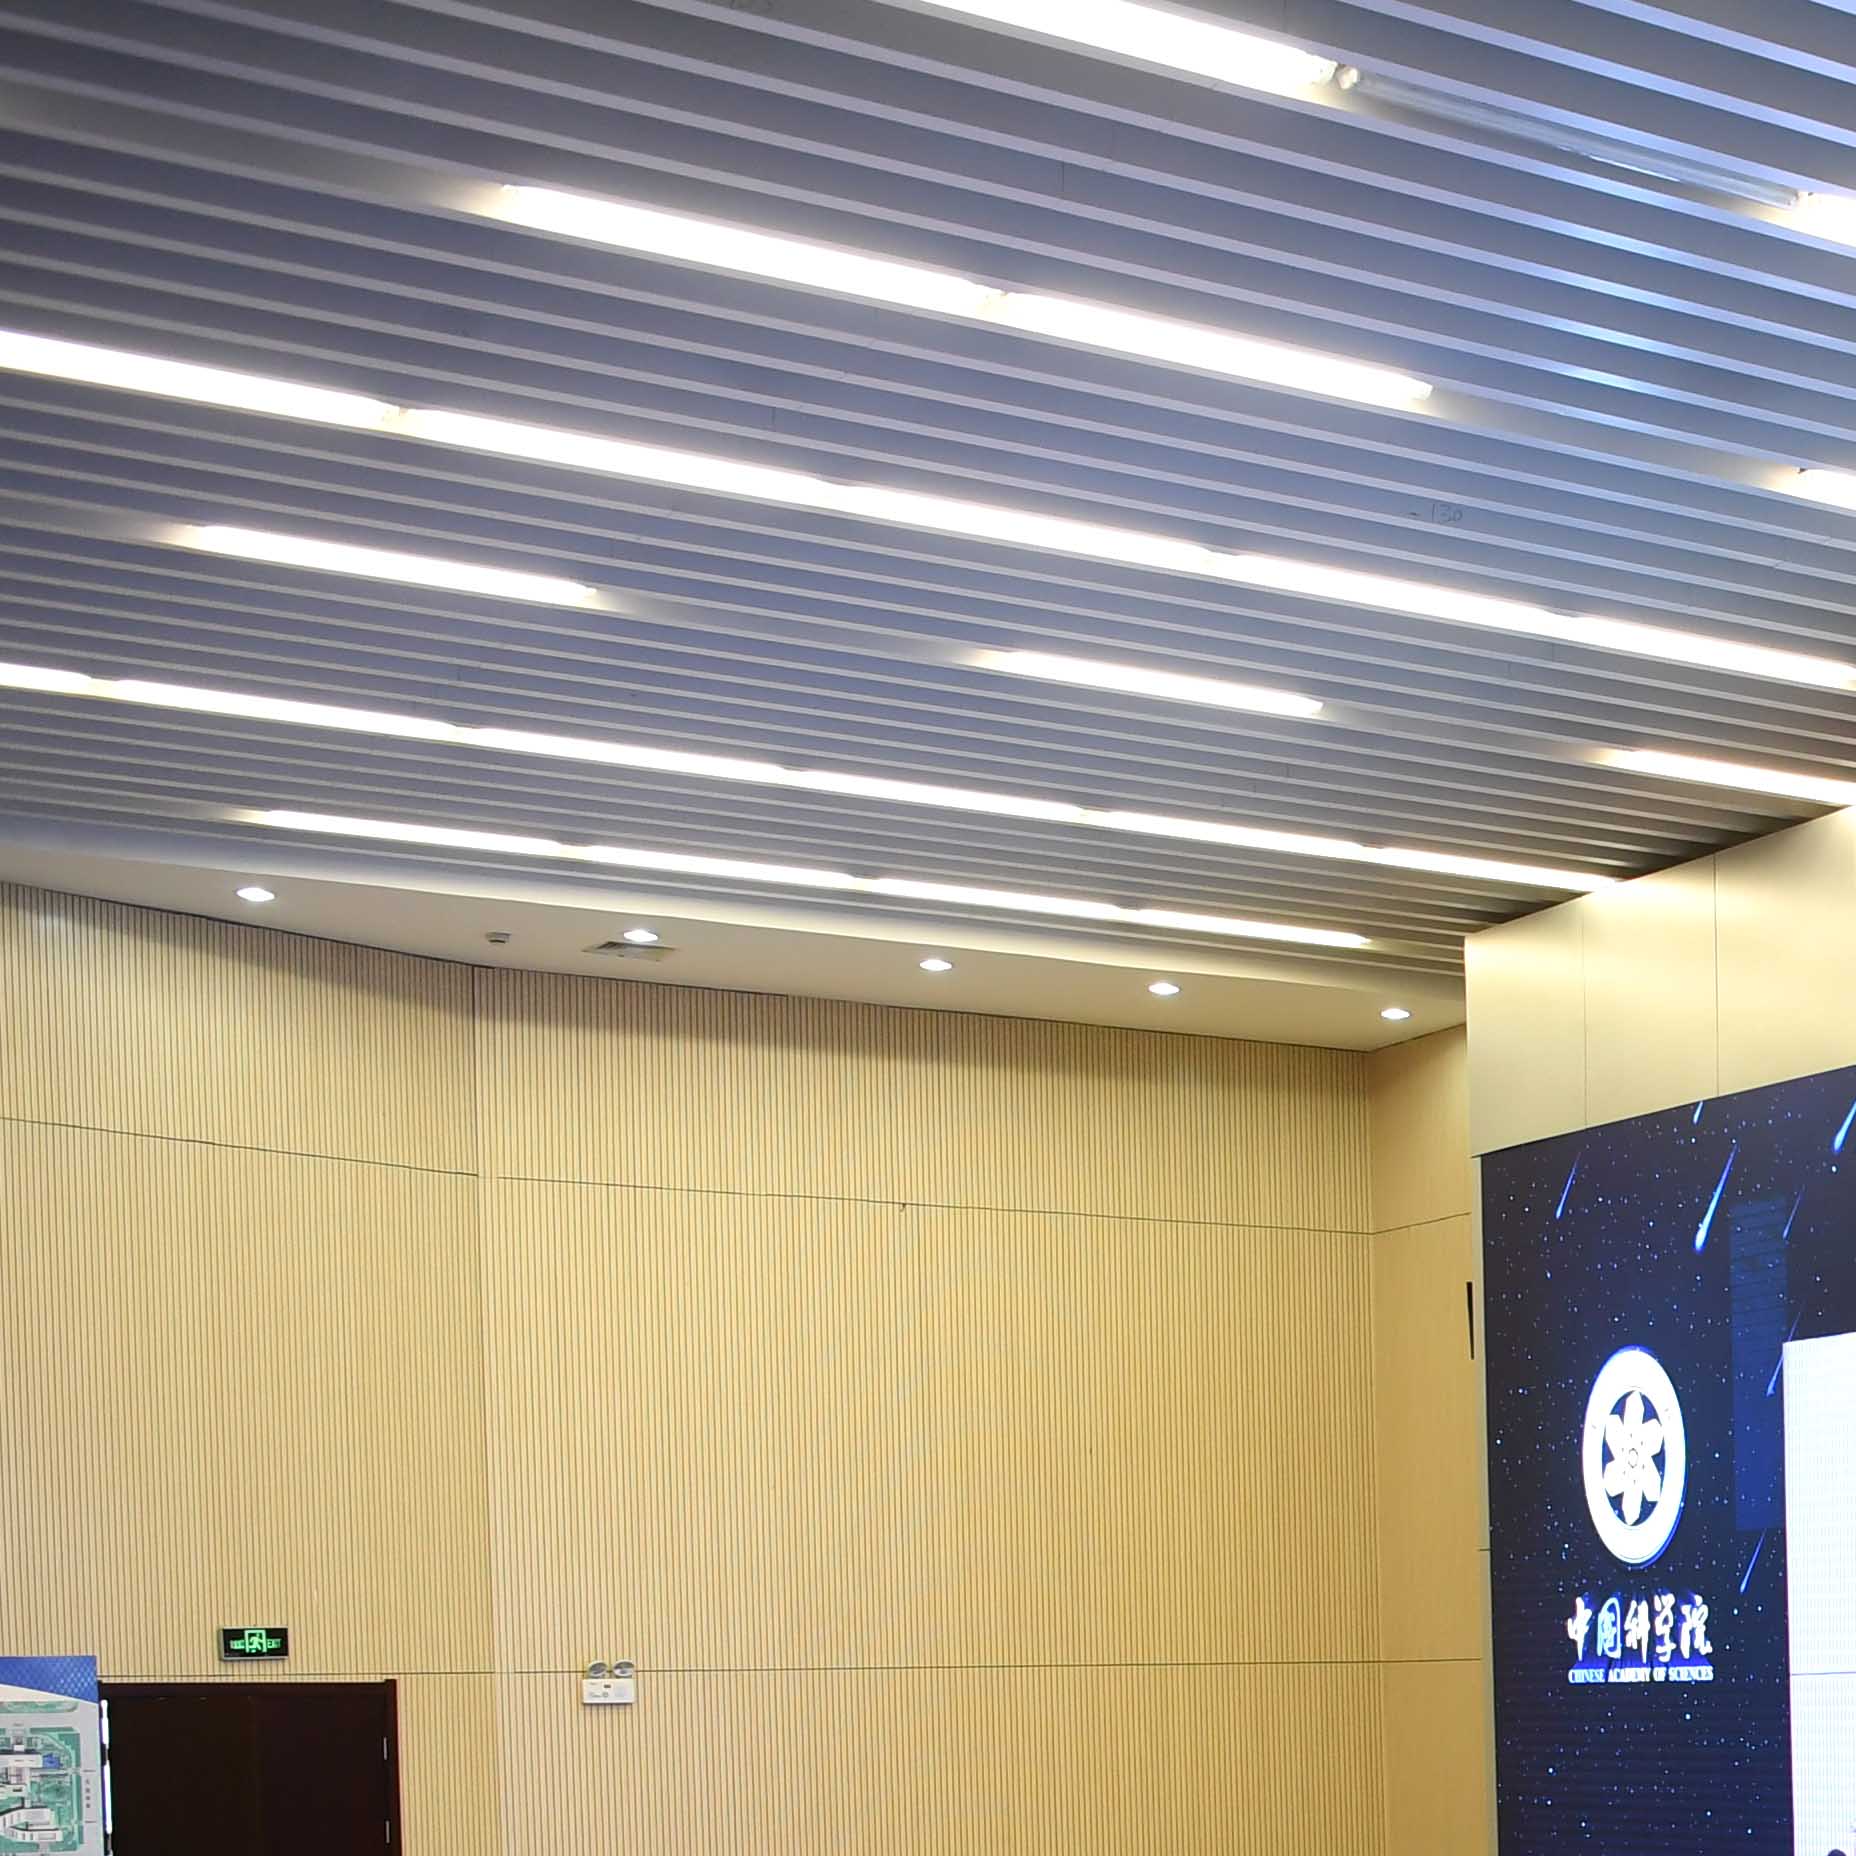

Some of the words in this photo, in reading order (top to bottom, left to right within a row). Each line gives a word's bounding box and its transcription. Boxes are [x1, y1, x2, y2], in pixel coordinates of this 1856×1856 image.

[1567, 1593, 1713, 1664] 中国科学院
[1568, 1668, 1606, 1683] CHINESE
[1607, 1667, 1651, 1683] ACADEMY
[1653, 1666, 1668, 1682] OF
[1668, 1666, 1714, 1682] SCIENCES
